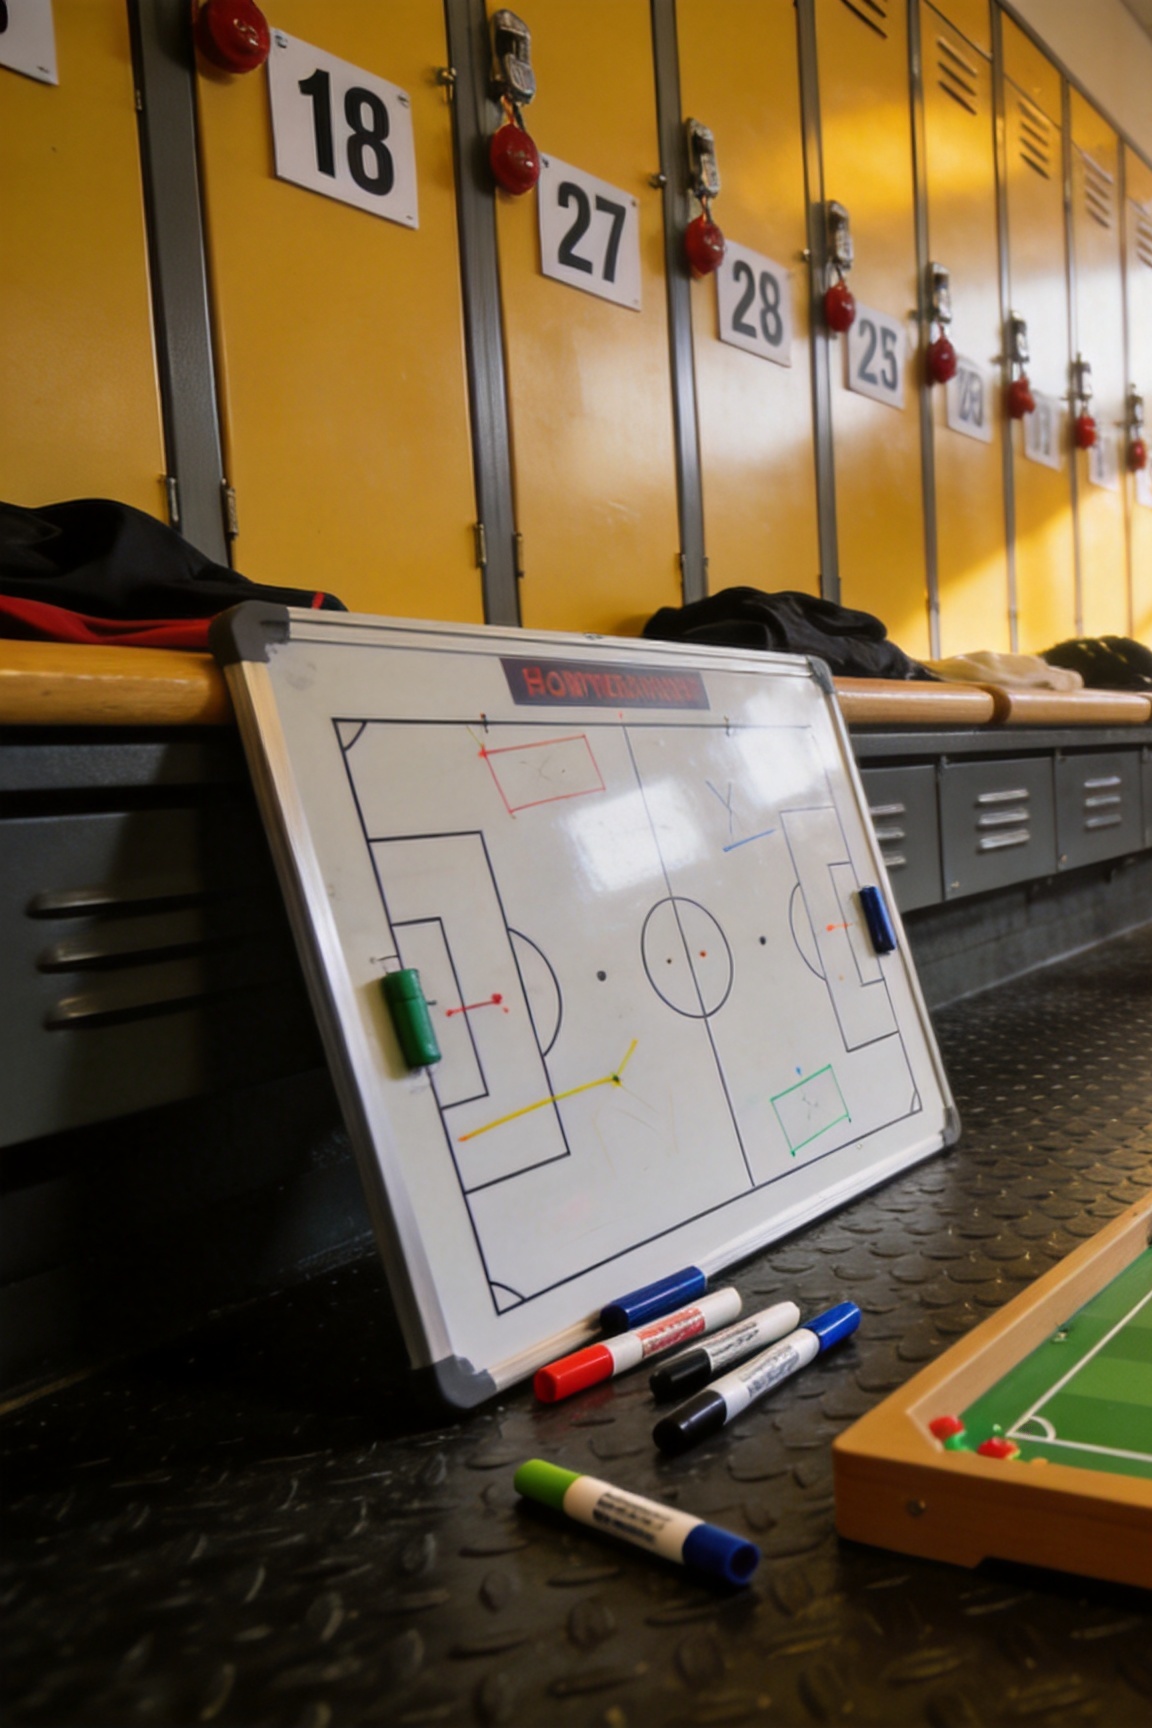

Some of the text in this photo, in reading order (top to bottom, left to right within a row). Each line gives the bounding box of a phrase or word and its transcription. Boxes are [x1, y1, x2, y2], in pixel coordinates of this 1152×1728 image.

[298, 69, 394, 196] 18
[557, 181, 626, 283] 27
[732, 260, 782, 347] 28
[858, 318, 897, 391] 25
